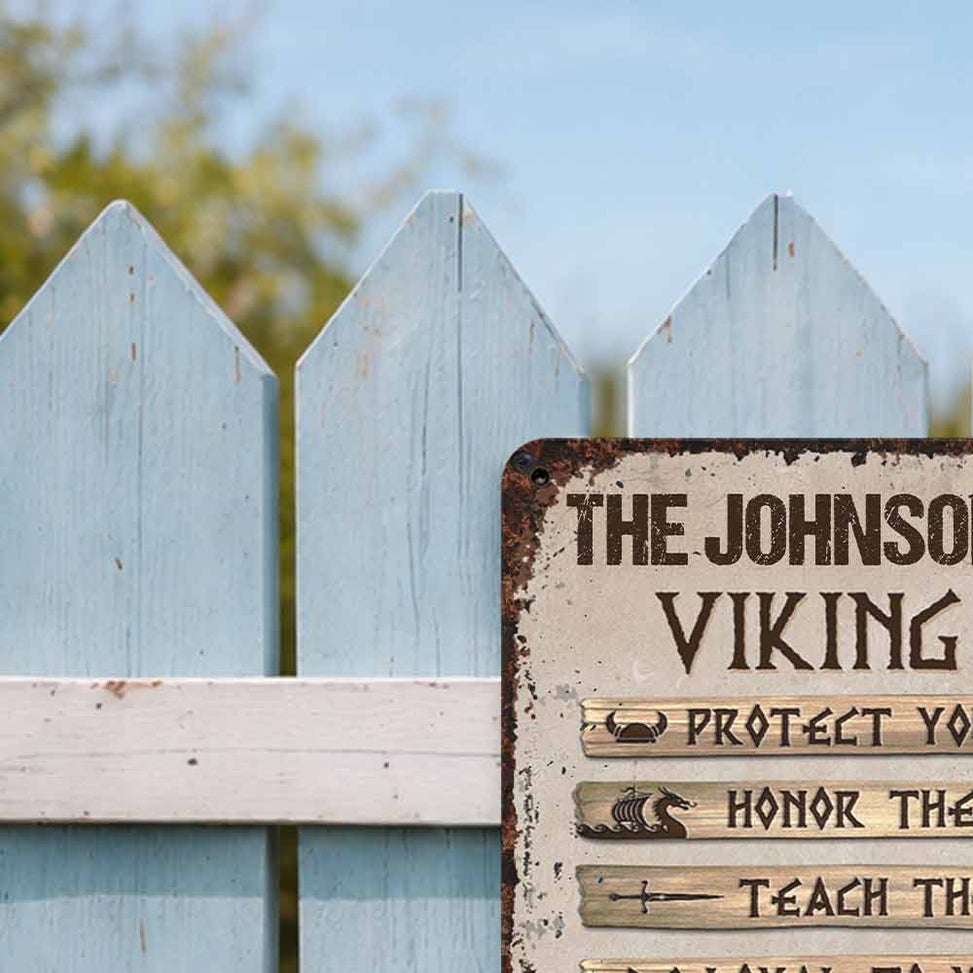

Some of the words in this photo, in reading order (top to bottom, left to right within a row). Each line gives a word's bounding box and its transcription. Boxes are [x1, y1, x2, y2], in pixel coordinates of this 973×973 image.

[571, 493, 688, 566] THE
[657, 589, 961, 674] VIKING
[686, 705, 892, 747] PROTECT
[726, 788, 863, 830] HONOR
[740, 875, 888, 918] TEACH
